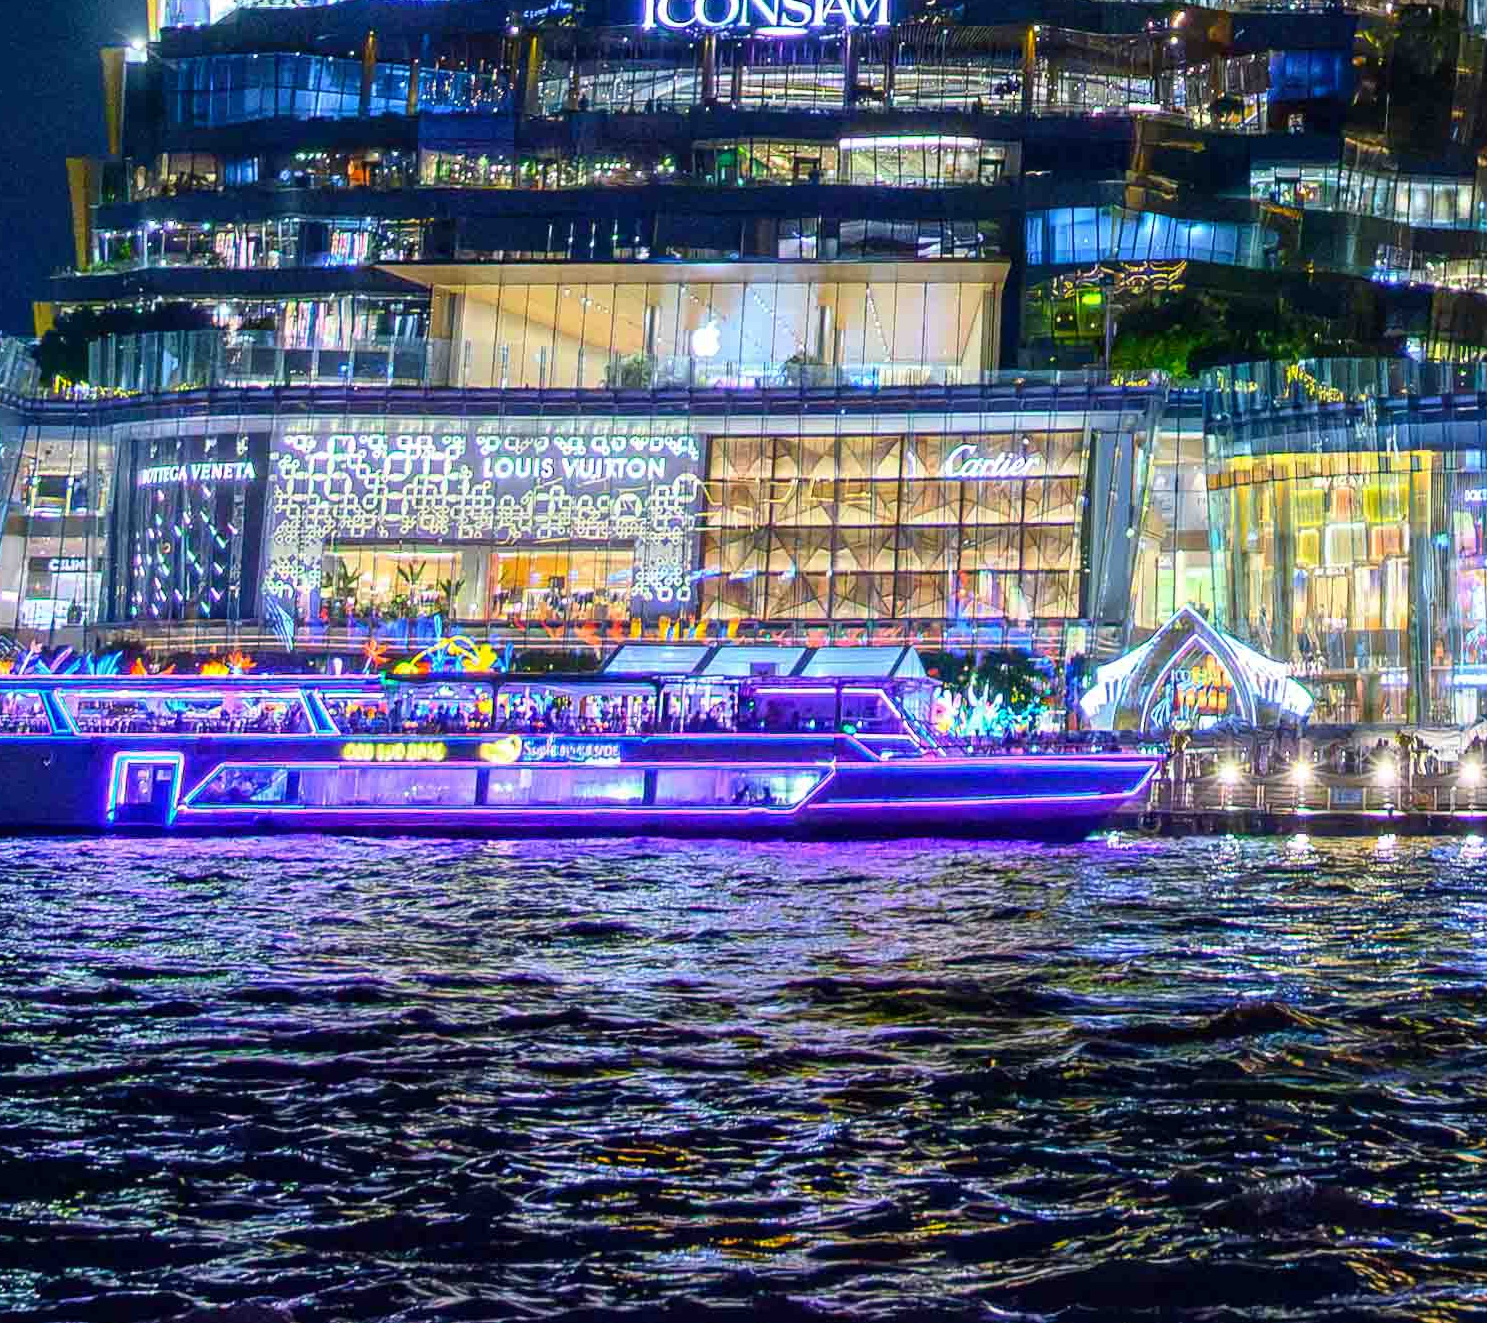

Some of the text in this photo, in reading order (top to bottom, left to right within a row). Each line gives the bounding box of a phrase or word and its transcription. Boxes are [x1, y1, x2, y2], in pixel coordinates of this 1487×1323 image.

[482, 457, 666, 479] LOUIS VUITTON
[944, 436, 1041, 477] Cartier
[140, 461, 258, 485] BOTTEGA VENETA
